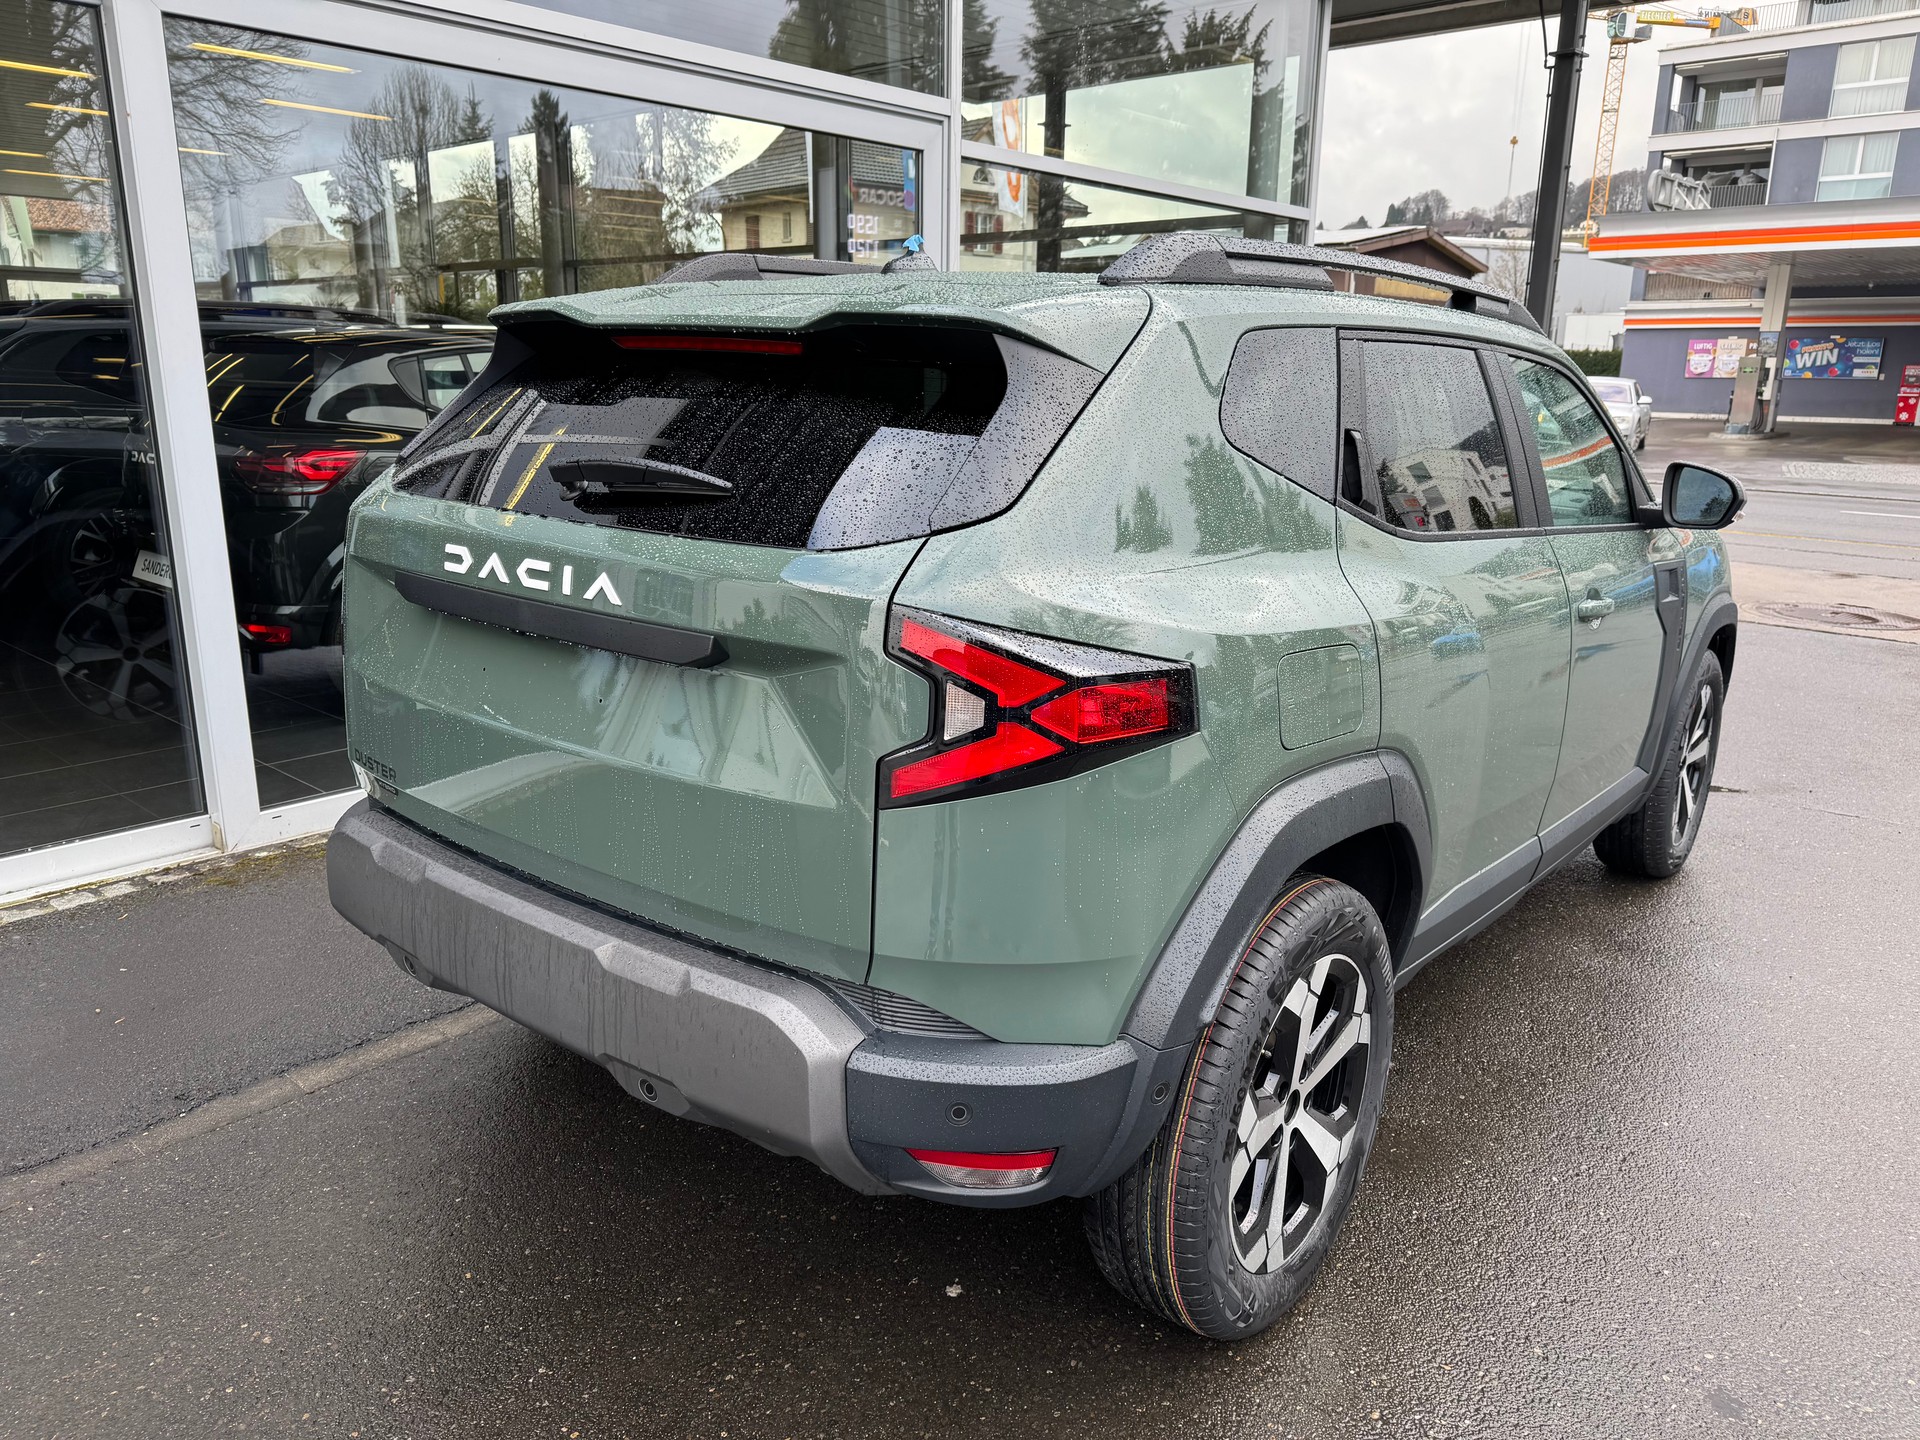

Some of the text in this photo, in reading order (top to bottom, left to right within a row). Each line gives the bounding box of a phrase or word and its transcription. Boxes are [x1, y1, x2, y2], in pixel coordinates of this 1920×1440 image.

[1693, 342, 1713, 350] LUFTIG
[1795, 348, 1840, 369] WIN
[442, 542, 623, 606] DACIA
[354, 748, 397, 783] DUSTER
